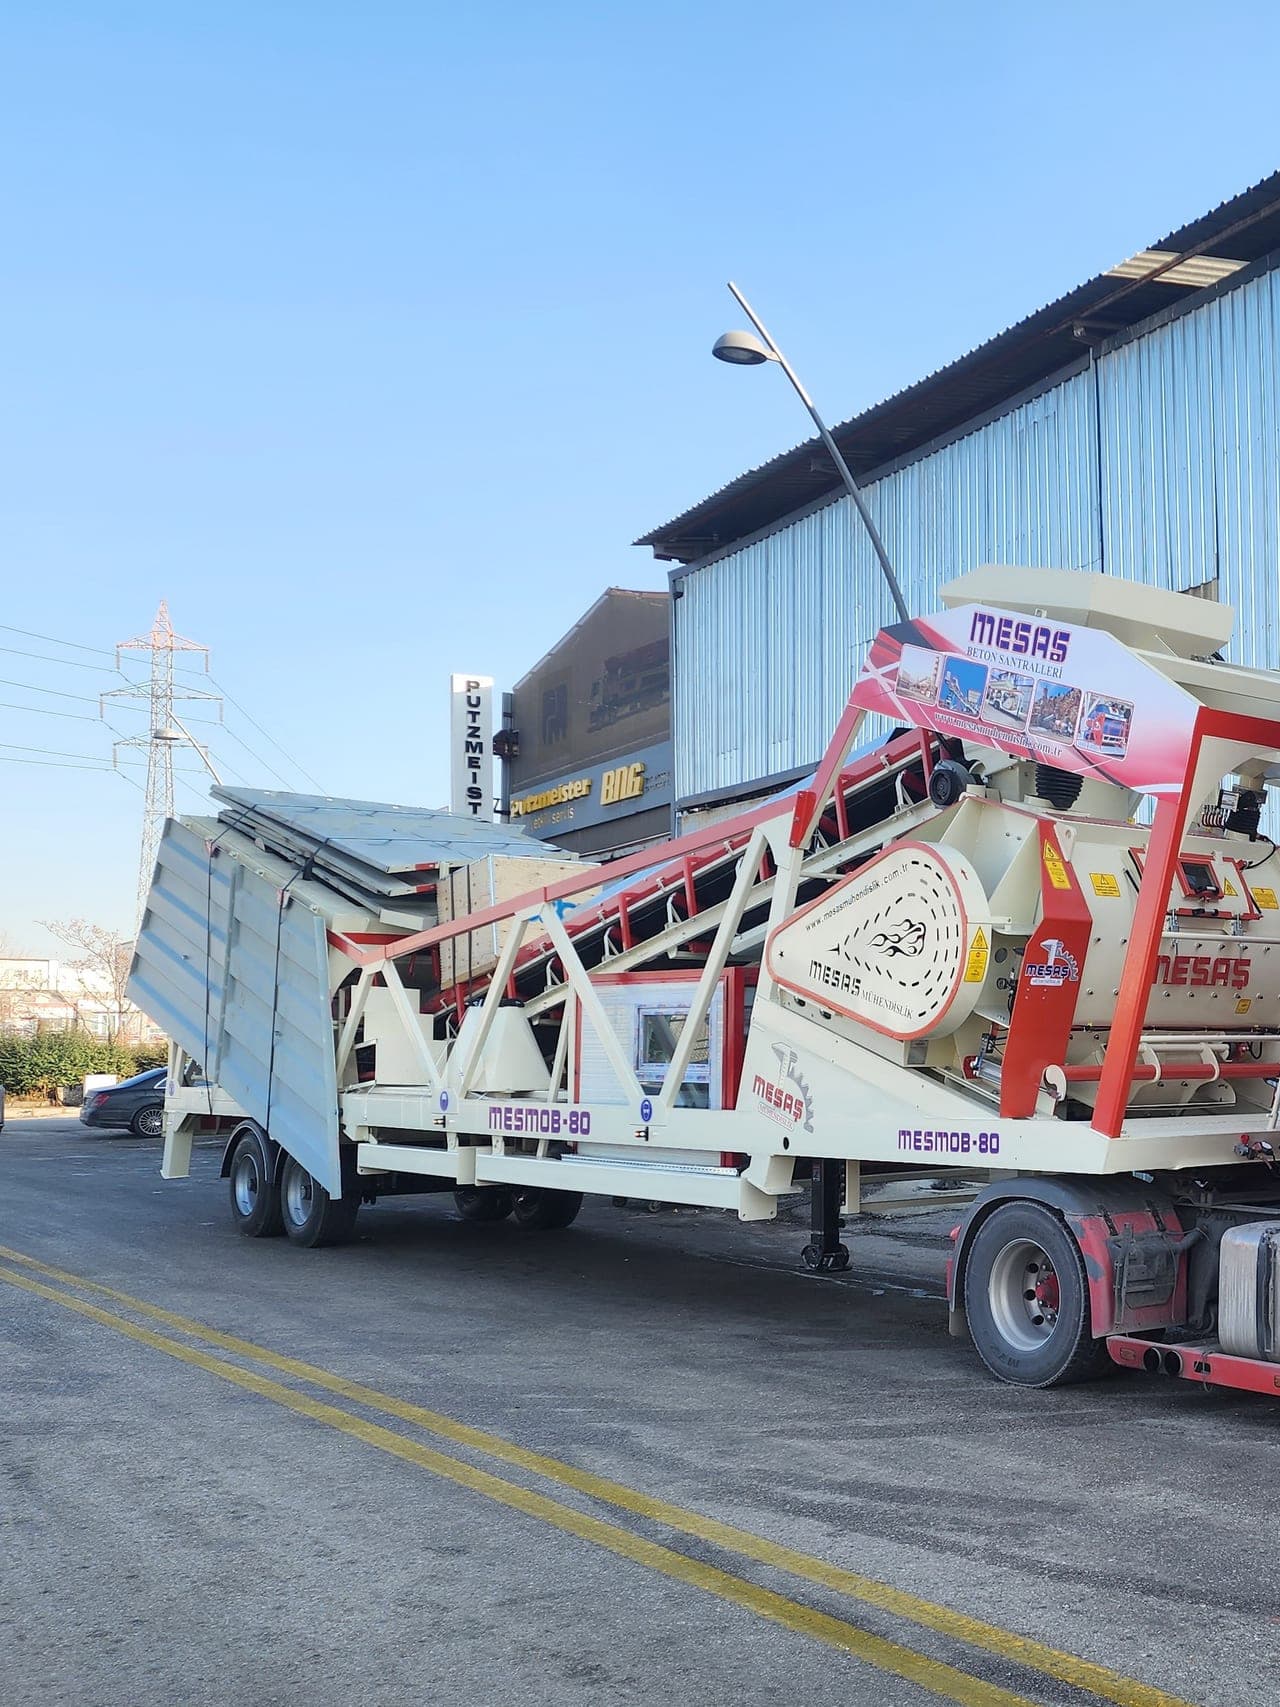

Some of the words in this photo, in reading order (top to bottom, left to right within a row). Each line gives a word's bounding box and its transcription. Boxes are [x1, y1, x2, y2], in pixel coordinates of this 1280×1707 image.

[966, 646, 997, 662] BETON
[998, 655, 1063, 679] SANTRALLERİ
[861, 989, 914, 1019] MÜHENDİSLİK
[488, 1106, 590, 1135] MESMOB-80
[898, 1129, 1000, 1154] MESMOB-80
